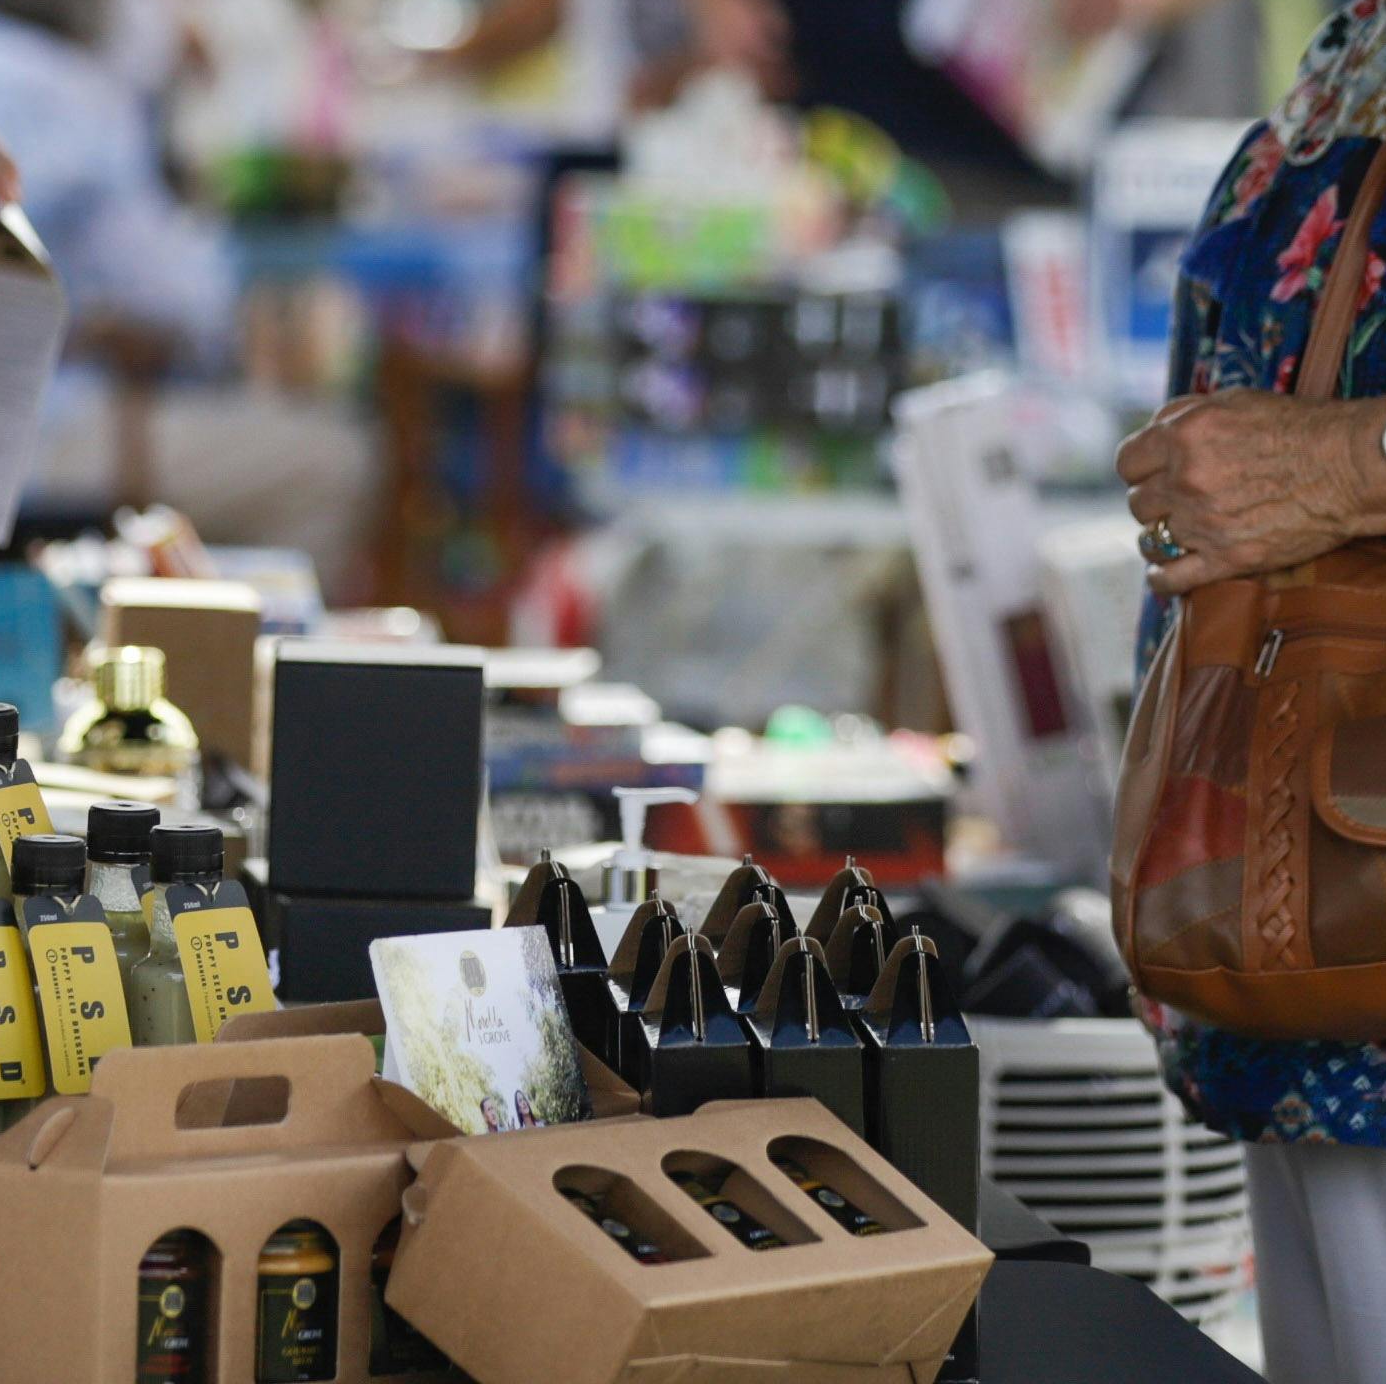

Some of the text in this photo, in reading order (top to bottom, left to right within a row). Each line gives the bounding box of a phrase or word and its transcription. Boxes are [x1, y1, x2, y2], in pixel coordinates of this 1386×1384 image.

[59, 947, 85, 1076] POPPY SEED DRESSING
[203, 934, 216, 968] POPPY
[213, 974, 223, 1001] SEED
